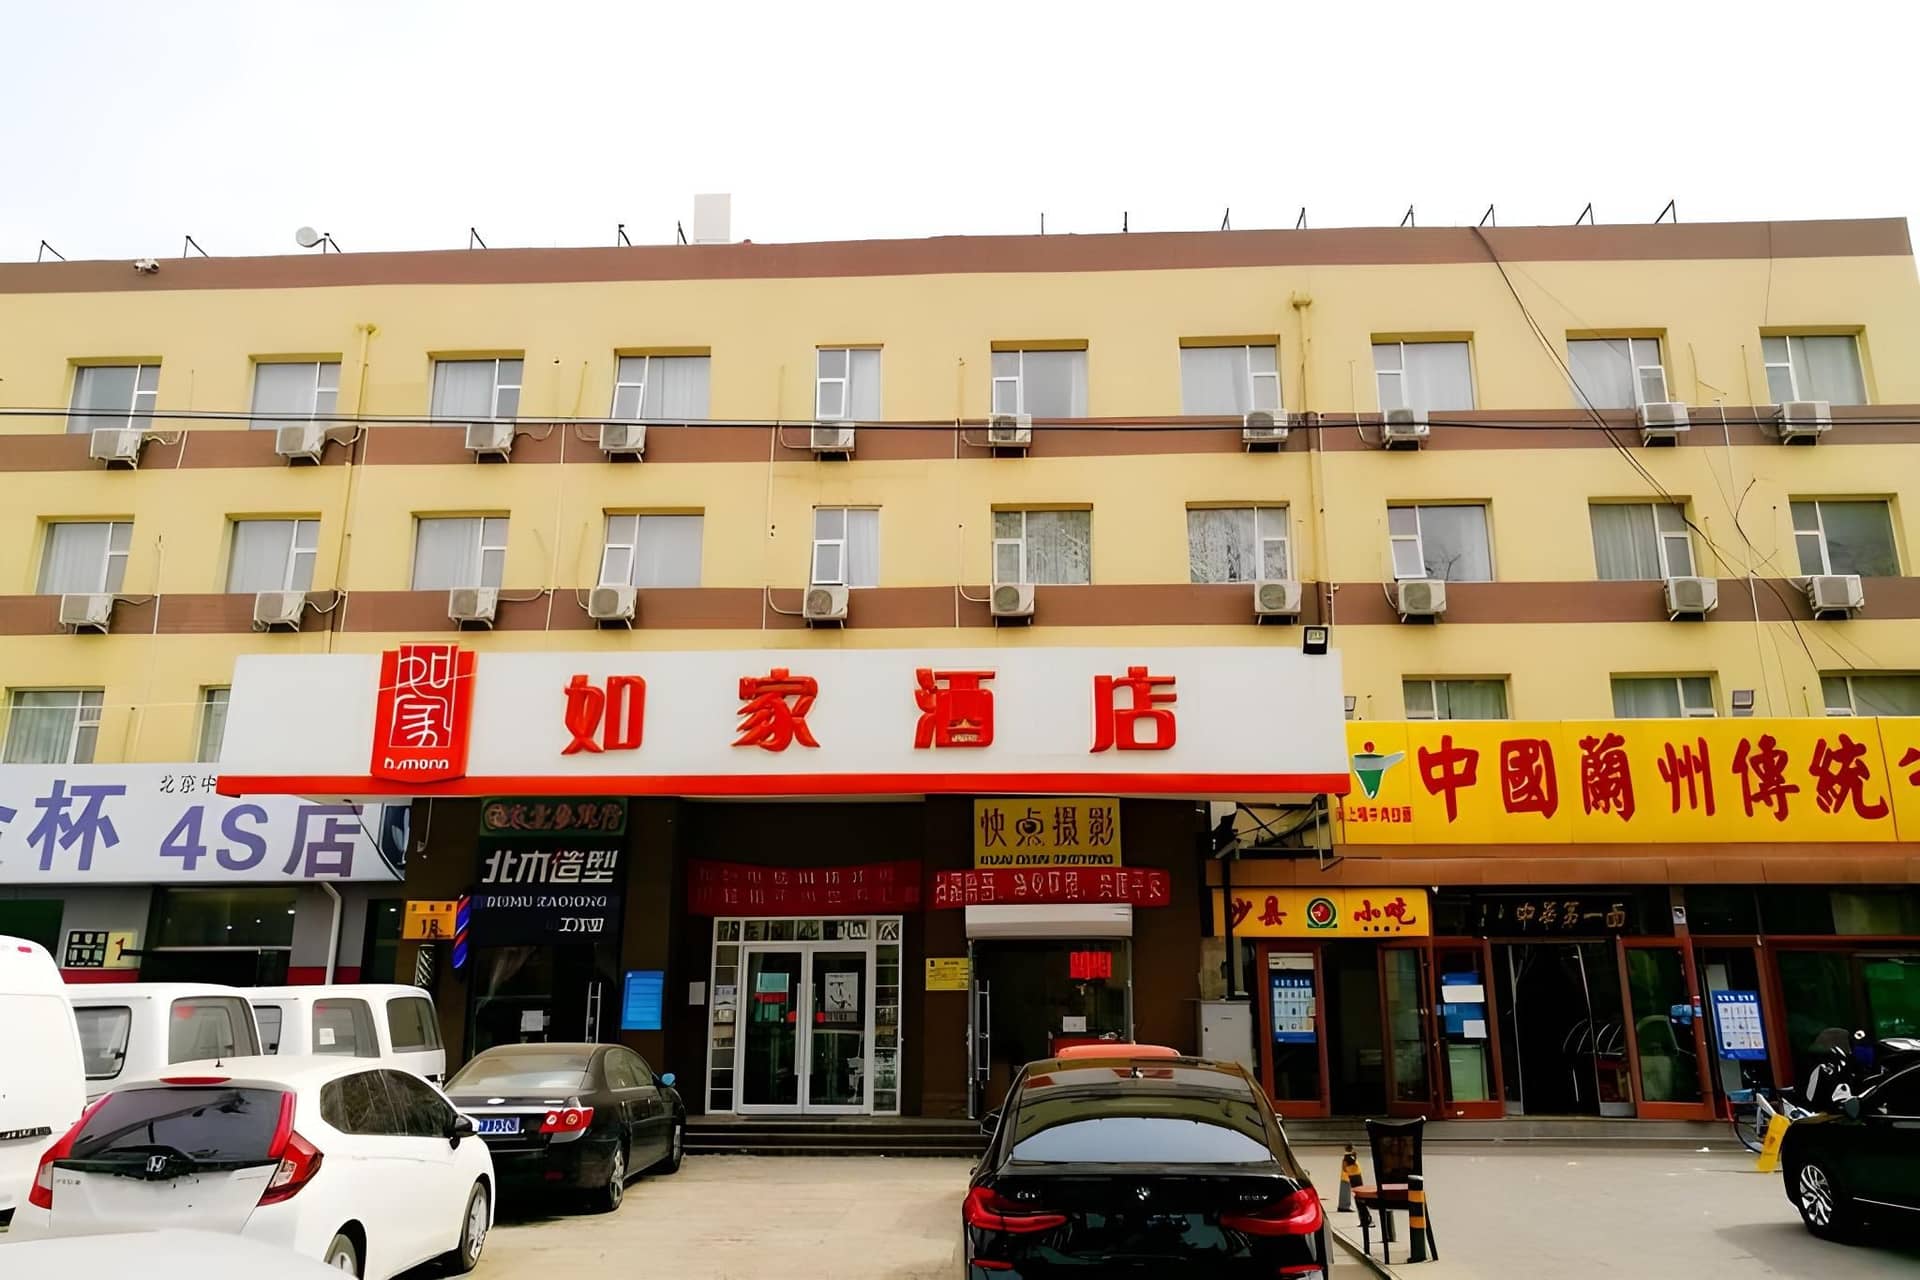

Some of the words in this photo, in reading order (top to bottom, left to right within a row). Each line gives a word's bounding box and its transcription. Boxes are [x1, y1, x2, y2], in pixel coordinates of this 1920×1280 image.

[561, 666, 1177, 753] 如家酒店
[1417, 733, 1920, 824] 中國蘭州傳統
[0, 780, 126, 871] 杯
